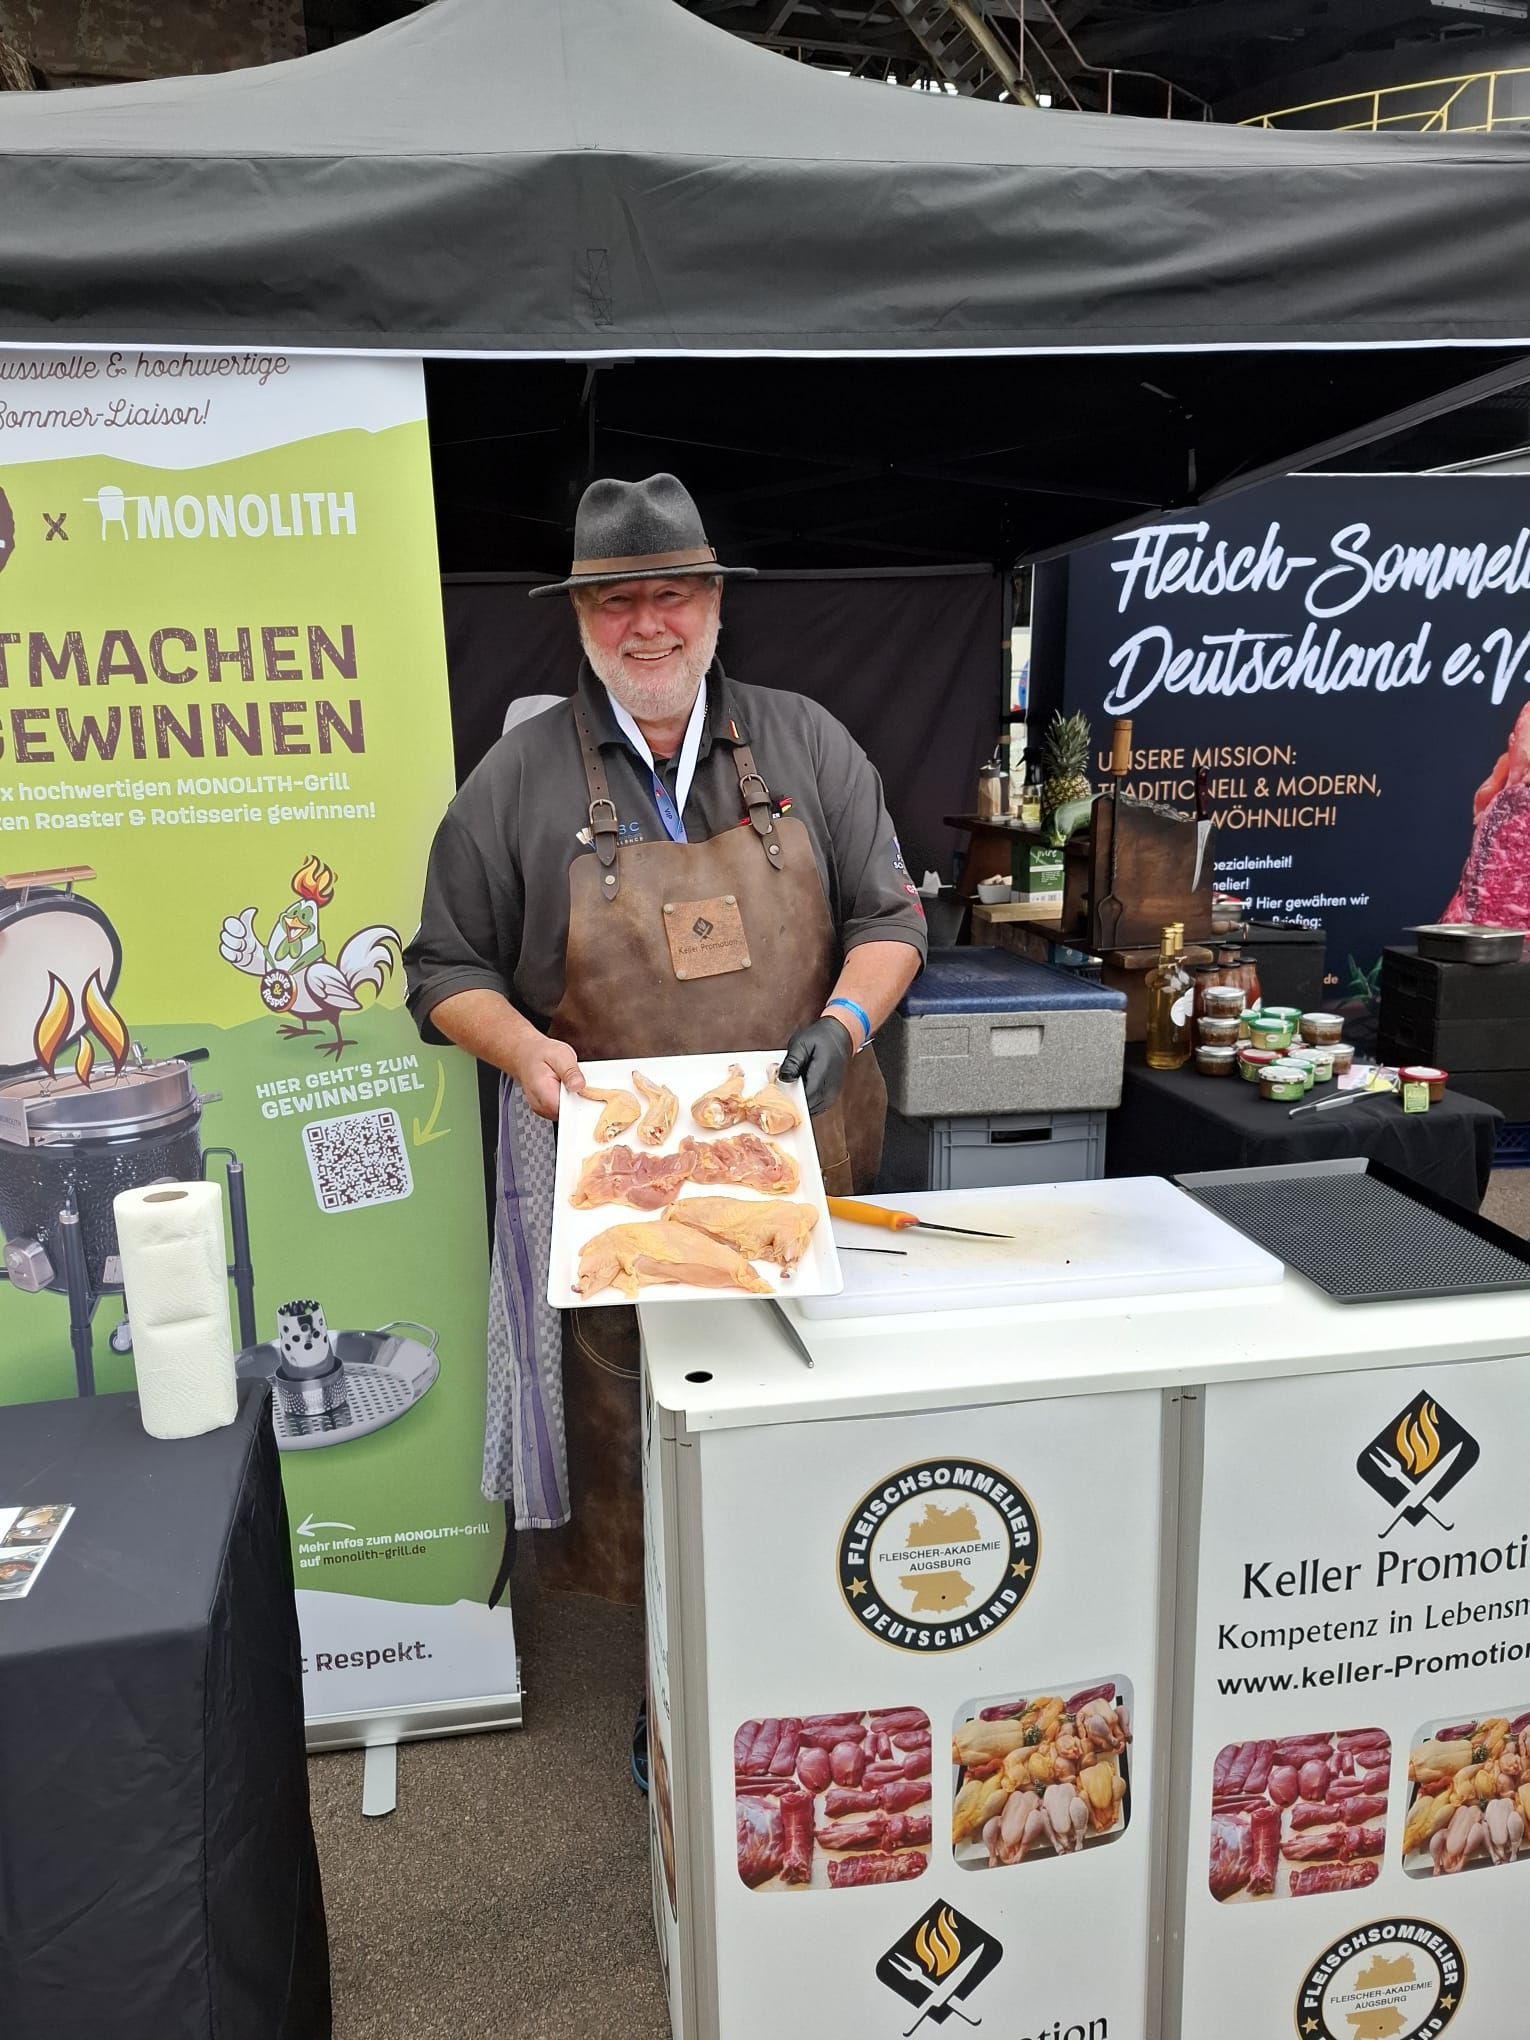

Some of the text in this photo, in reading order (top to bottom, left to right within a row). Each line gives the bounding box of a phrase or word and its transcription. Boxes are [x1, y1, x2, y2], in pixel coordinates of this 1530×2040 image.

[106, 352, 127, 378] &
[135, 352, 290, 386] hochwertige
[136, 492, 357, 539] MONOLITH
[1103, 622, 1432, 715] Deutschland
[0, 700, 366, 764] EWINNEN
[1098, 745, 1297, 772] USERE MISSION:
[18, 779, 171, 801] hochwertigen
[177, 772, 350, 796] MONOLITH-Grill
[1254, 779, 1269, 798] &
[1276, 774, 1382, 798] MODERN,
[0, 801, 376, 831] en Roaster & Rotisserie gewinnen!
[1210, 804, 1337, 830] WÖHNLICH!
[1256, 896, 1282, 909] Hier
[1285, 893, 1347, 911] gewähren
[1350, 893, 1369, 906] wir
[700, 940, 738, 953] Promotion
[264, 971, 290, 989] Nature
[273, 983, 282, 995] &
[262, 988, 291, 1008] Respect
[256, 1078, 301, 1098] HIER
[376, 1054, 419, 1074] ZUM
[261, 1072, 424, 1119] GEWINNSPIEL
[848, 1467, 1031, 1565] FLEISCHSOMMELIER
[298, 1522, 490, 1554] Mehr Infos zum MONOLITH-Grill
[879, 1540, 1001, 1562] FLEISCHER-AKADEMIE
[300, 1544, 426, 1569] auf monolith-grill.de
[909, 1557, 971, 1572] AUGSBURG
[1243, 1534, 1529, 1600] Keller Promoti
[862, 1589, 1018, 1646] DEUTSCHLAND
[1217, 1617, 1378, 1650] Kompetenz
[1389, 1610, 1413, 1634] in
[316, 1640, 433, 1673] Respekt.
[1304, 1924, 1459, 2008] FLEISCHSOMMELIER
[1330, 1980, 1433, 2004] FLEISCHER-AKADEMIE
[1354, 1995, 1407, 2010] AUGSBURG
